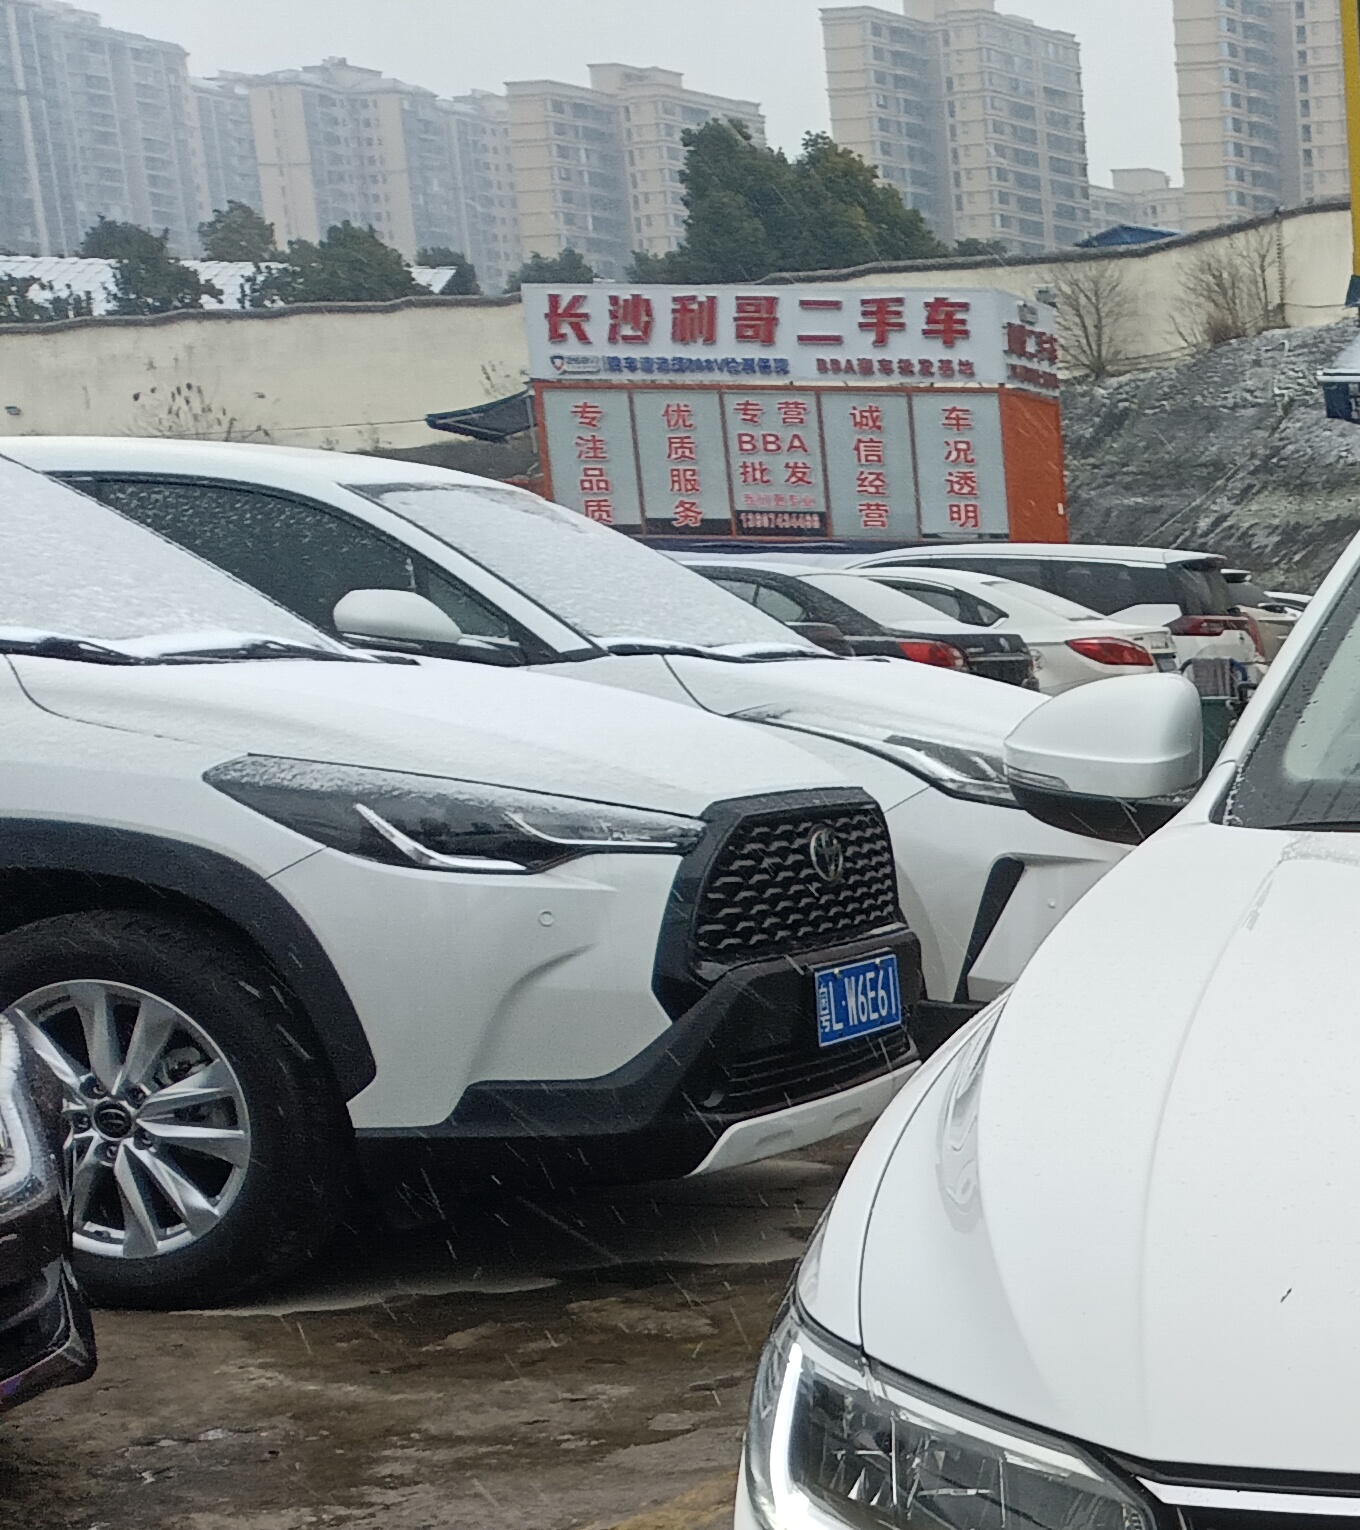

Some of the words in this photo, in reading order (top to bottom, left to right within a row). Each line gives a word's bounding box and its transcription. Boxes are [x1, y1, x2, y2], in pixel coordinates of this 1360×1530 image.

[543, 293, 971, 348] 长沙利哥二手车
[733, 400, 808, 425] 专营
[736, 432, 809, 454] BBA
[570, 401, 614, 525] 专注品质
[662, 403, 702, 526] 优质服务
[739, 461, 812, 486] 批发
[849, 404, 889, 528] 诚信经营
[941, 406, 980, 528] 车况透明
